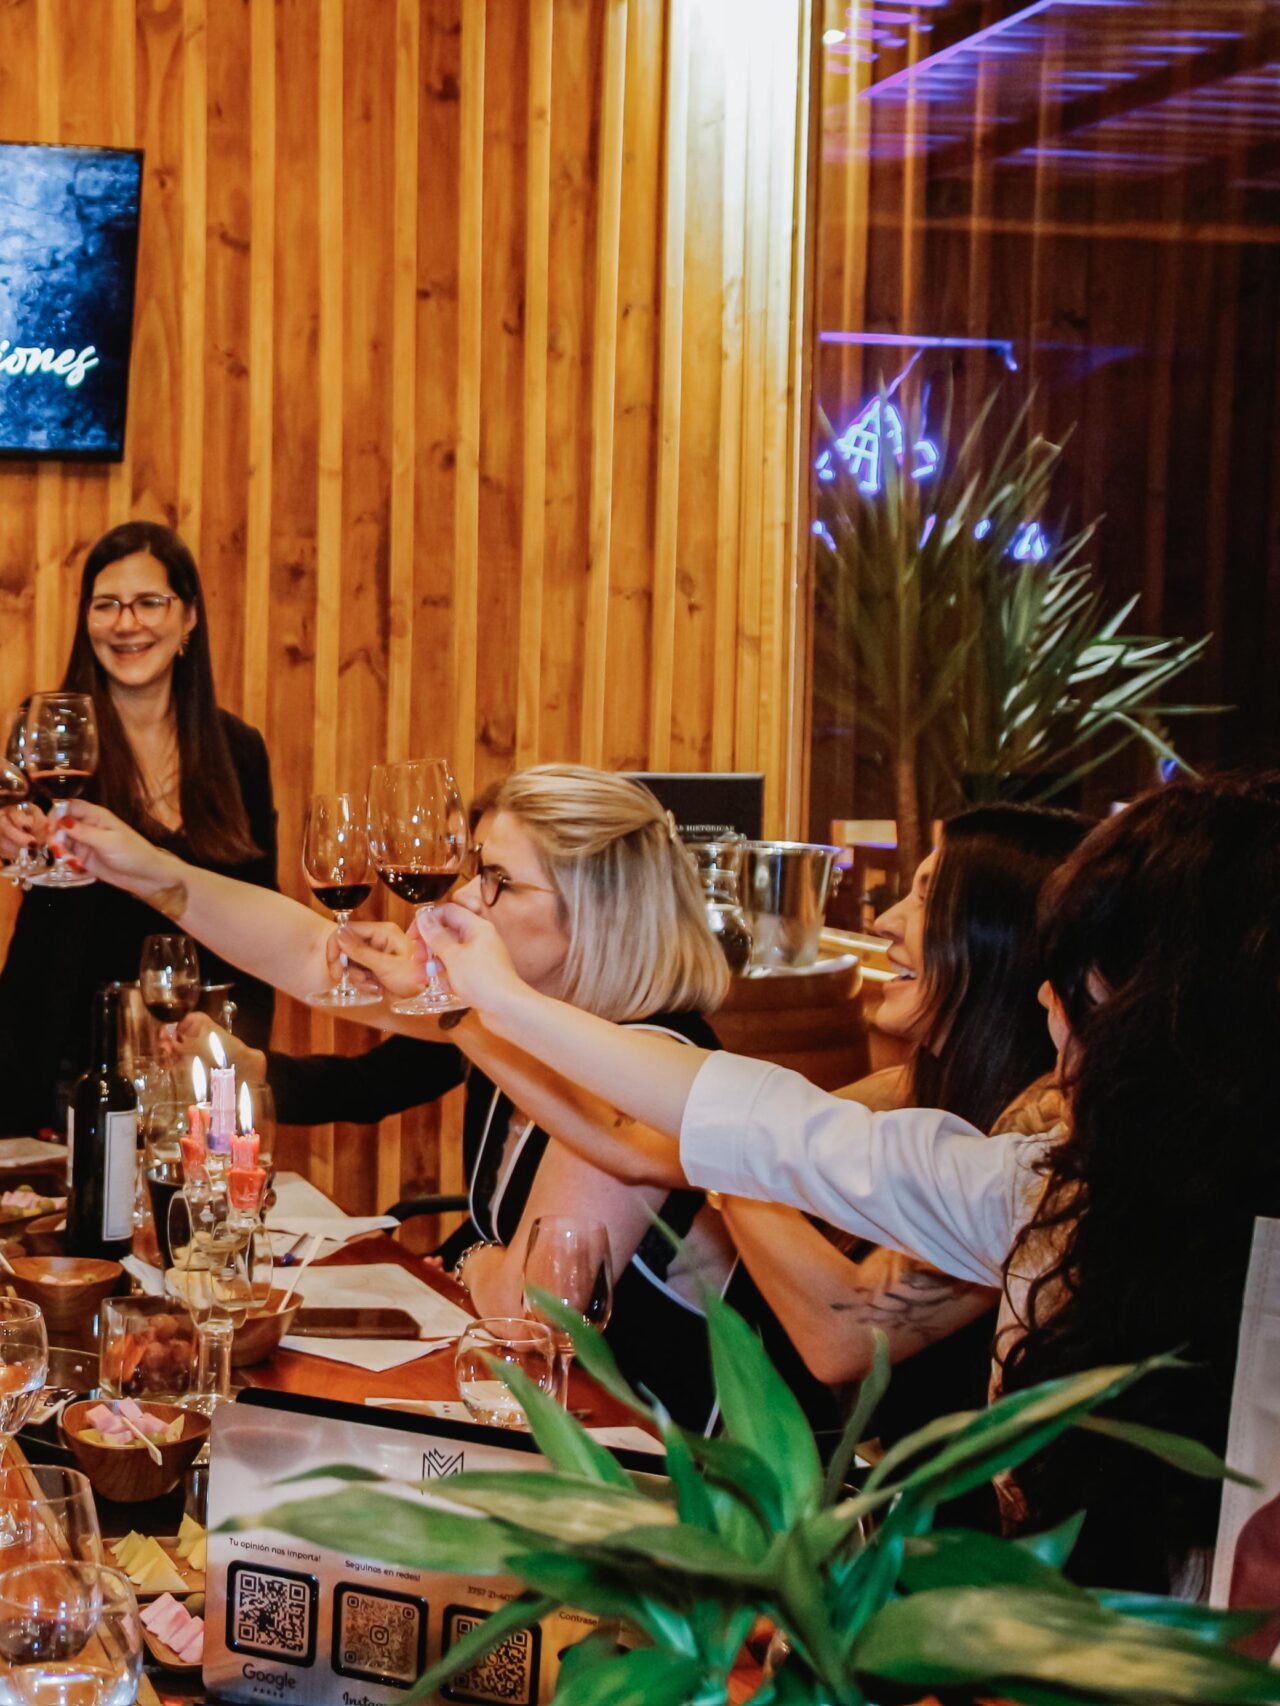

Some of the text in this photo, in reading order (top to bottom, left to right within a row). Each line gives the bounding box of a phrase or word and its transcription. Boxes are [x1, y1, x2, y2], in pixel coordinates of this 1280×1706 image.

[228, 1537, 239, 1547] Tu
[240, 1541, 270, 1553] opinión
[271, 1546, 286, 1556] nos
[345, 1559, 382, 1575] Seguinos
[383, 1568, 395, 1576] en
[559, 1610, 598, 1626] Contrase
[242, 1662, 297, 1690] Google
